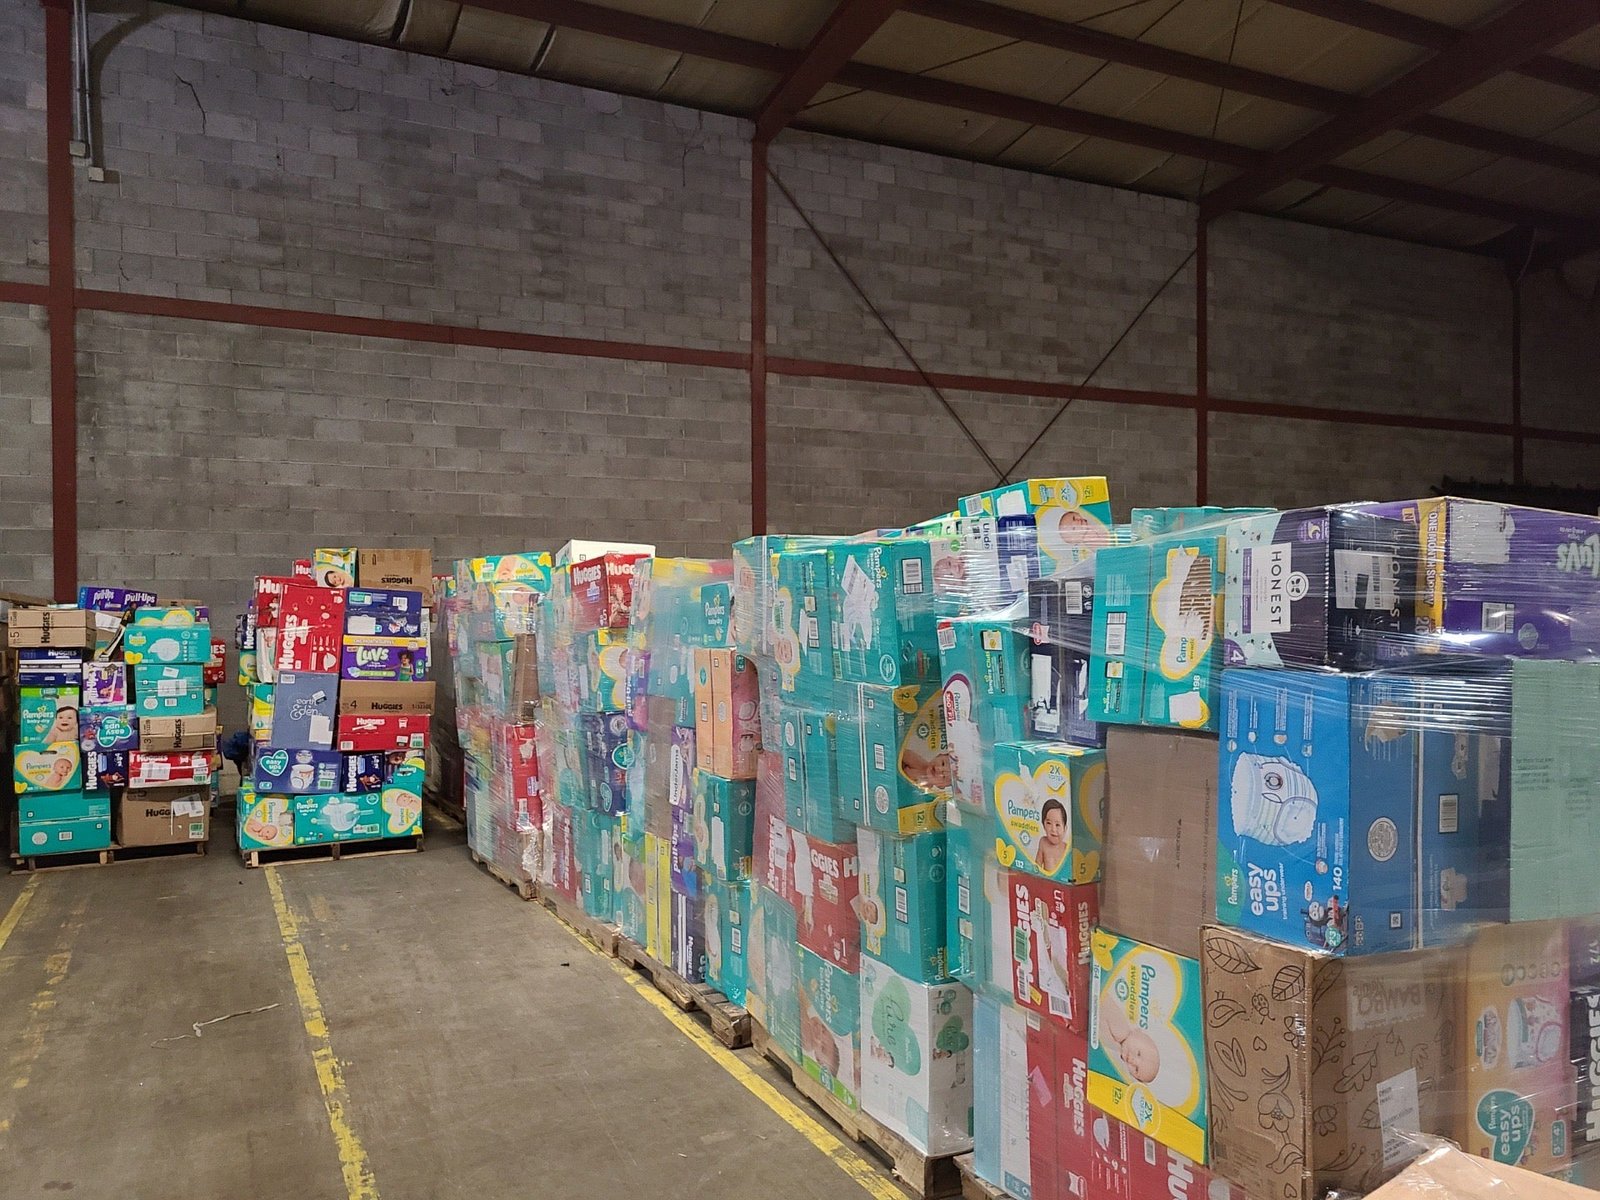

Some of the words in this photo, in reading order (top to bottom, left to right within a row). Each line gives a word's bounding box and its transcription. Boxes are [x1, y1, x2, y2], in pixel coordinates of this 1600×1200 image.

[1427, 512, 1437, 533] ONE
[1426, 533, 1437, 567] MONTH
[1556, 533, 1600, 578] Luvs
[381, 577, 413, 585] HUGGIES
[573, 564, 602, 586] HUGGIES
[873, 547, 883, 589] Pampers
[1270, 550, 1282, 625] HONEST
[602, 609, 608, 621] 5
[705, 602, 725, 618] Pampers
[10, 631, 20, 639] 5
[41, 612, 51, 644] HUGGIES
[244, 613, 256, 649] HUGGIES
[279, 614, 298, 669] HUGGIES
[356, 646, 389, 666] Luvs
[1176, 637, 1189, 663] Pamp
[1230, 650, 1244, 662] 4
[23, 709, 54, 720] Pampers
[350, 700, 357, 709] 4
[371, 702, 403, 710] HUGGIES
[173, 719, 182, 748] HUGGIES
[86, 751, 98, 790] HUGGIES
[1049, 765, 1060, 774] 2X
[145, 808, 173, 817] HUGG
[1007, 799, 1040, 821] Pampers
[1010, 820, 1039, 832] swaddlers
[672, 823, 681, 874] Pull-Ups
[1003, 850, 1008, 859] 5
[811, 849, 840, 879] GGIES
[1080, 863, 1086, 874] 5
[1332, 866, 1343, 891] 140
[1226, 868, 1239, 905] Pampers
[1247, 862, 1265, 916] easy
[1262, 868, 1281, 912] ups
[1078, 901, 1089, 965] HUGGIES
[934, 947, 945, 980] Pampers
[823, 961, 834, 1024] Pampers
[1128, 965, 1136, 1021] swaddlers
[1139, 964, 1156, 1030] Pampers
[1357, 984, 1422, 1016] BAMBO
[1071, 1058, 1086, 1137] HUGGIES
[1144, 1101, 1153, 1123] 2X
[1499, 1108, 1511, 1156] easy
[1511, 1104, 1523, 1142] ups
